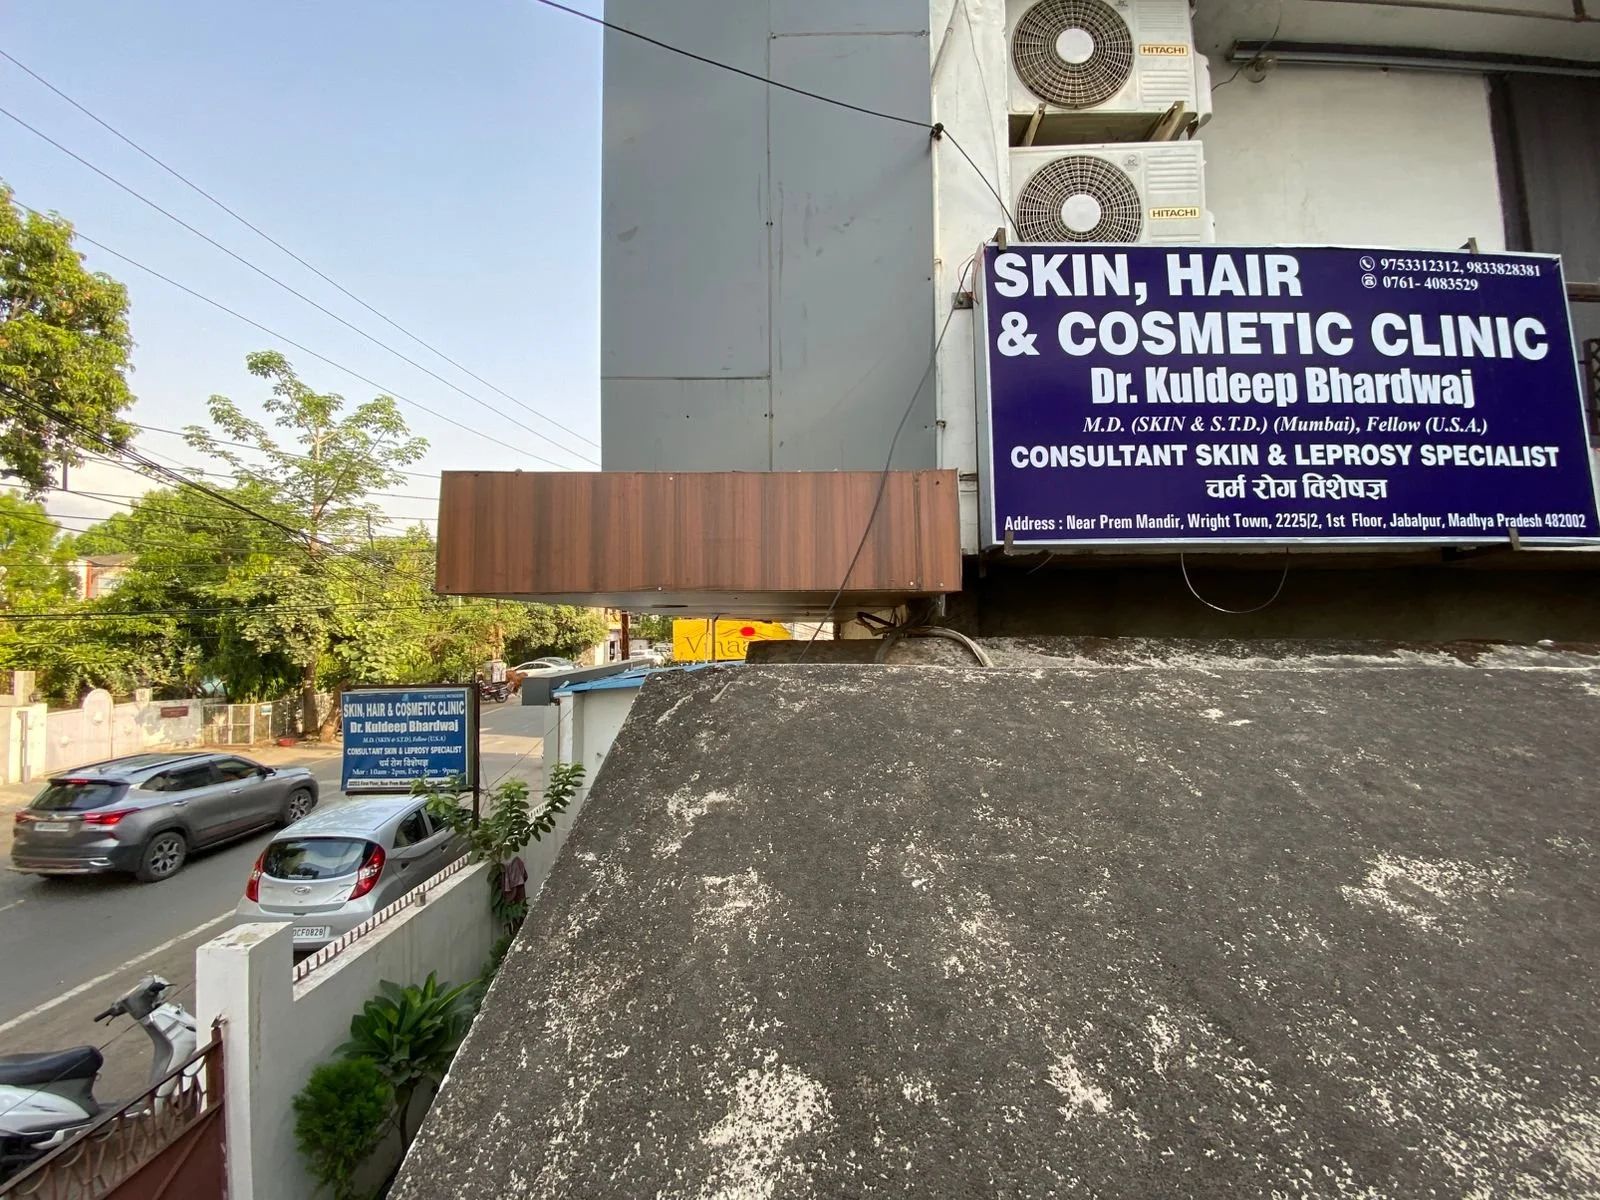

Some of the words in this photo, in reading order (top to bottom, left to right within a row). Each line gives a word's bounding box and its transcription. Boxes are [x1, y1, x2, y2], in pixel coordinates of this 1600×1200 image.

[1142, 46, 1185, 54] HITACHI
[1152, 208, 1197, 218] HITACHI
[1381, 258, 1464, 274] 9753312312,
[1466, 261, 1541, 277] 9833828381
[994, 252, 1147, 306] SKIN,
[1166, 254, 1303, 296] HAIR
[1382, 275, 1421, 289] 0761-
[1424, 276, 1479, 291] 4083529
[997, 311, 1040, 357] &
[1058, 311, 1353, 356] COSMETIC
[1371, 312, 1549, 360] CLINIC
[1091, 368, 1138, 404] Dr.
[1145, 367, 1298, 408] Kuldeep
[1304, 367, 1476, 408] Bhardwaj
[1083, 416, 1125, 432] M.D.
[1131, 416, 1187, 434] (SKIN
[1190, 416, 1205, 432] &
[1210, 416, 1268, 434] S.T.D.)
[1273, 416, 1361, 436] (Mumbai),
[1366, 416, 1421, 433] Fellow
[1425, 417, 1488, 436] (U.S.A.)
[1010, 444, 1188, 468] CONSULTANT
[1196, 444, 1260, 466] SKIN
[1267, 444, 1288, 466] &
[1295, 444, 1413, 466] LEPROSY
[1420, 445, 1559, 468] SPECIALIST
[1205, 474, 1247, 499] चर्म
[1252, 474, 1297, 500] रोग
[1302, 472, 1389, 500] विशेषज्ञ
[1004, 514, 1055, 531] Address
[1066, 514, 1096, 530] Near
[1099, 514, 1133, 530] Prem
[1136, 514, 1184, 530] Mandir,
[1187, 513, 1230, 532] Wright
[1233, 513, 1272, 530] Town,
[1326, 512, 1345, 528] 1st
[1352, 512, 1386, 529] Floor,
[1389, 512, 1445, 531] Jabalpur,
[1448, 512, 1494, 530] Madhya
[1497, 513, 1542, 528] Pradesh
[1545, 514, 1587, 528] 482002
[343, 703, 365, 718] SKIN,
[366, 702, 386, 717] HAIR
[387, 702, 393, 717] &
[395, 702, 436, 716] COSMETIC
[438, 700, 464, 716] CLINIC
[350, 722, 364, 734] Dr.
[365, 720, 407, 734] Kuldeep
[409, 720, 459, 732] Bhardwaj
[347, 747, 384, 756] CONSULTANT
[384, 747, 397, 755] SKIN
[404, 746, 430, 755] LEPROSY
[430, 746, 462, 754] SPECIALIST
